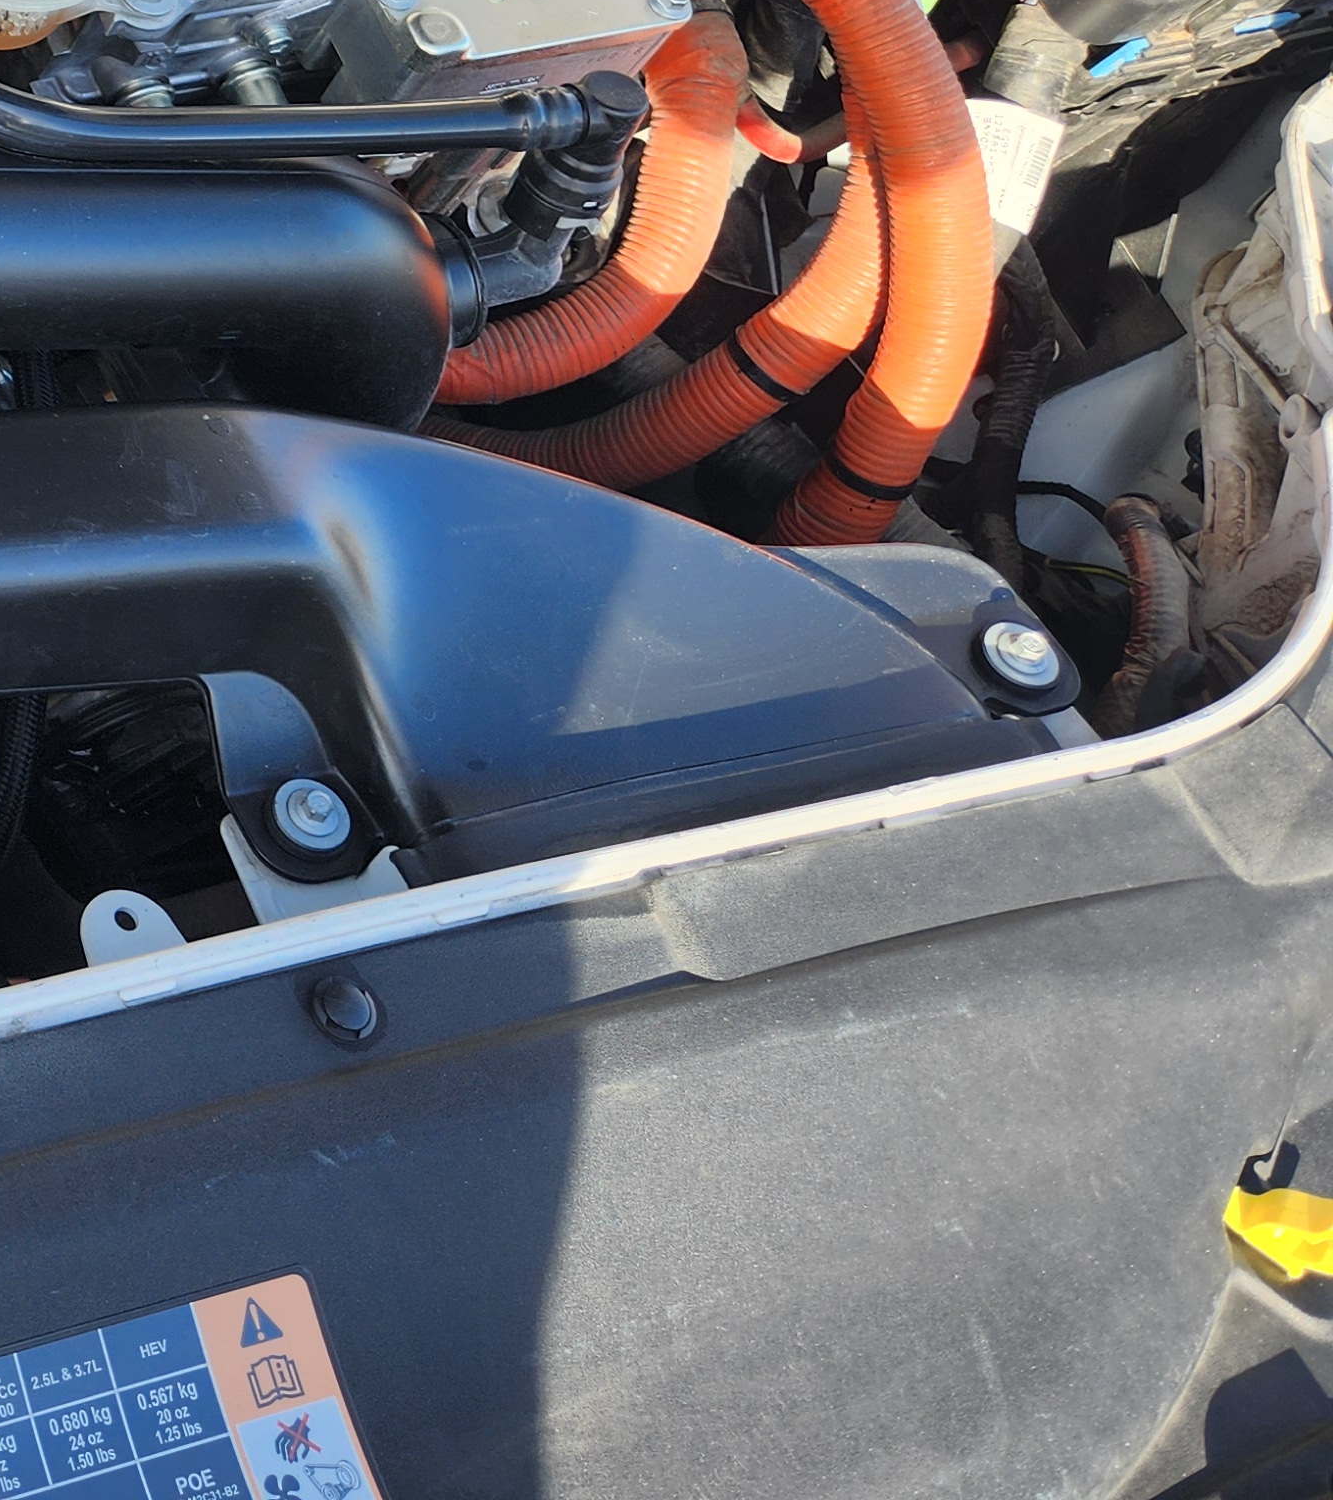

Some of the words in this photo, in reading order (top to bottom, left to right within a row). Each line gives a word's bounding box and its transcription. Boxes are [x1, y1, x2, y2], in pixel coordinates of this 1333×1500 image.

[139, 1339, 169, 1358] HEV
[30, 1371, 60, 1390] 2.5L
[61, 1367, 73, 1381] &
[73, 1358, 102, 1378] 3.7L
[136, 1385, 177, 1411] 0.567
[176, 1378, 199, 1403] kg
[48, 1409, 91, 1437] 0.680
[91, 1403, 113, 1428] kg
[156, 1408, 174, 1425] 20
[174, 1406, 190, 1420] oz
[68, 1434, 86, 1451] 24
[86, 1431, 104, 1446] oz
[155, 1425, 183, 1446] 1.25
[182, 1419, 203, 1437] lbs
[67, 1452, 95, 1472] 1.50
[94, 1445, 117, 1464] lbs
[0, 1473, 21, 1492] lbs
[175, 1468, 216, 1495] POE
